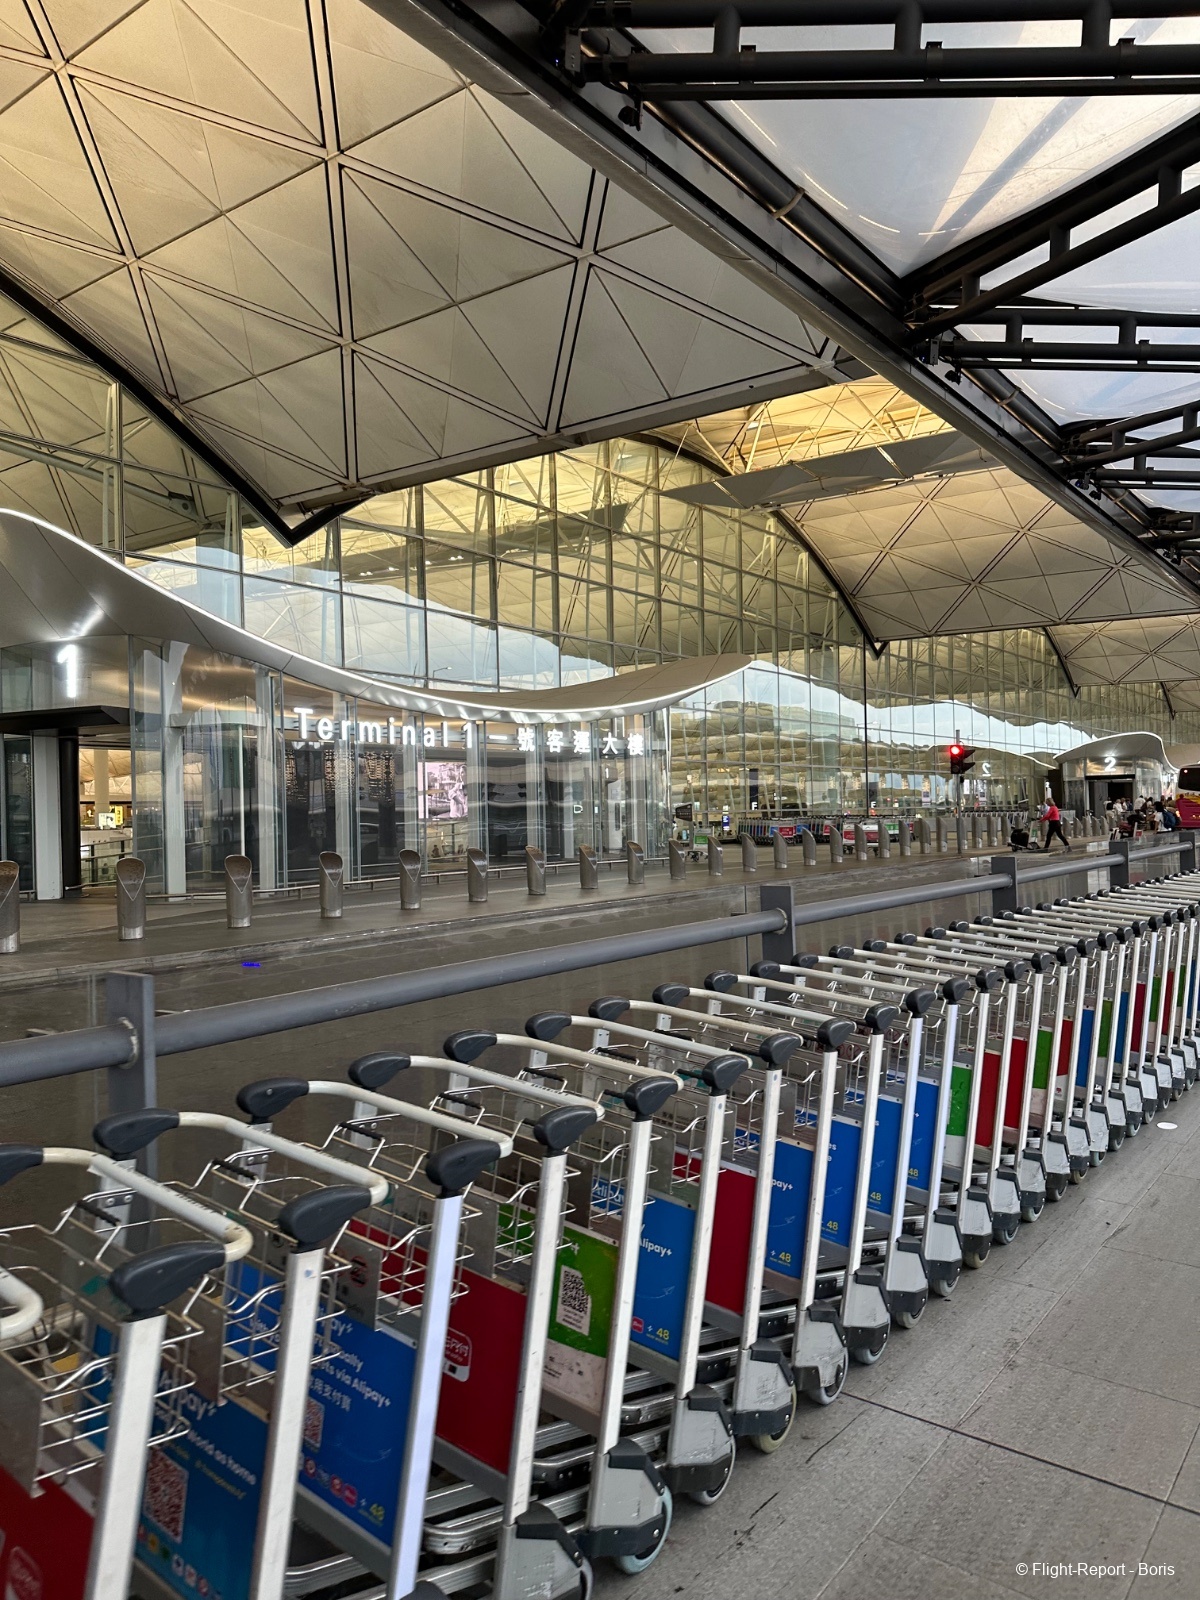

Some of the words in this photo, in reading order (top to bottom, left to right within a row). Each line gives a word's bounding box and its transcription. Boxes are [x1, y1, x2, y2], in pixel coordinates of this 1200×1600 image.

[57, 643, 77, 698] 1
[293, 707, 449, 748] Terminal
[461, 720, 474, 749] 1
[1104, 756, 1117, 772] 2
[870, 1191, 882, 1201] 48
[826, 1220, 839, 1231] 48
[779, 1252, 792, 1263] 48
[656, 1327, 670, 1341] 48
